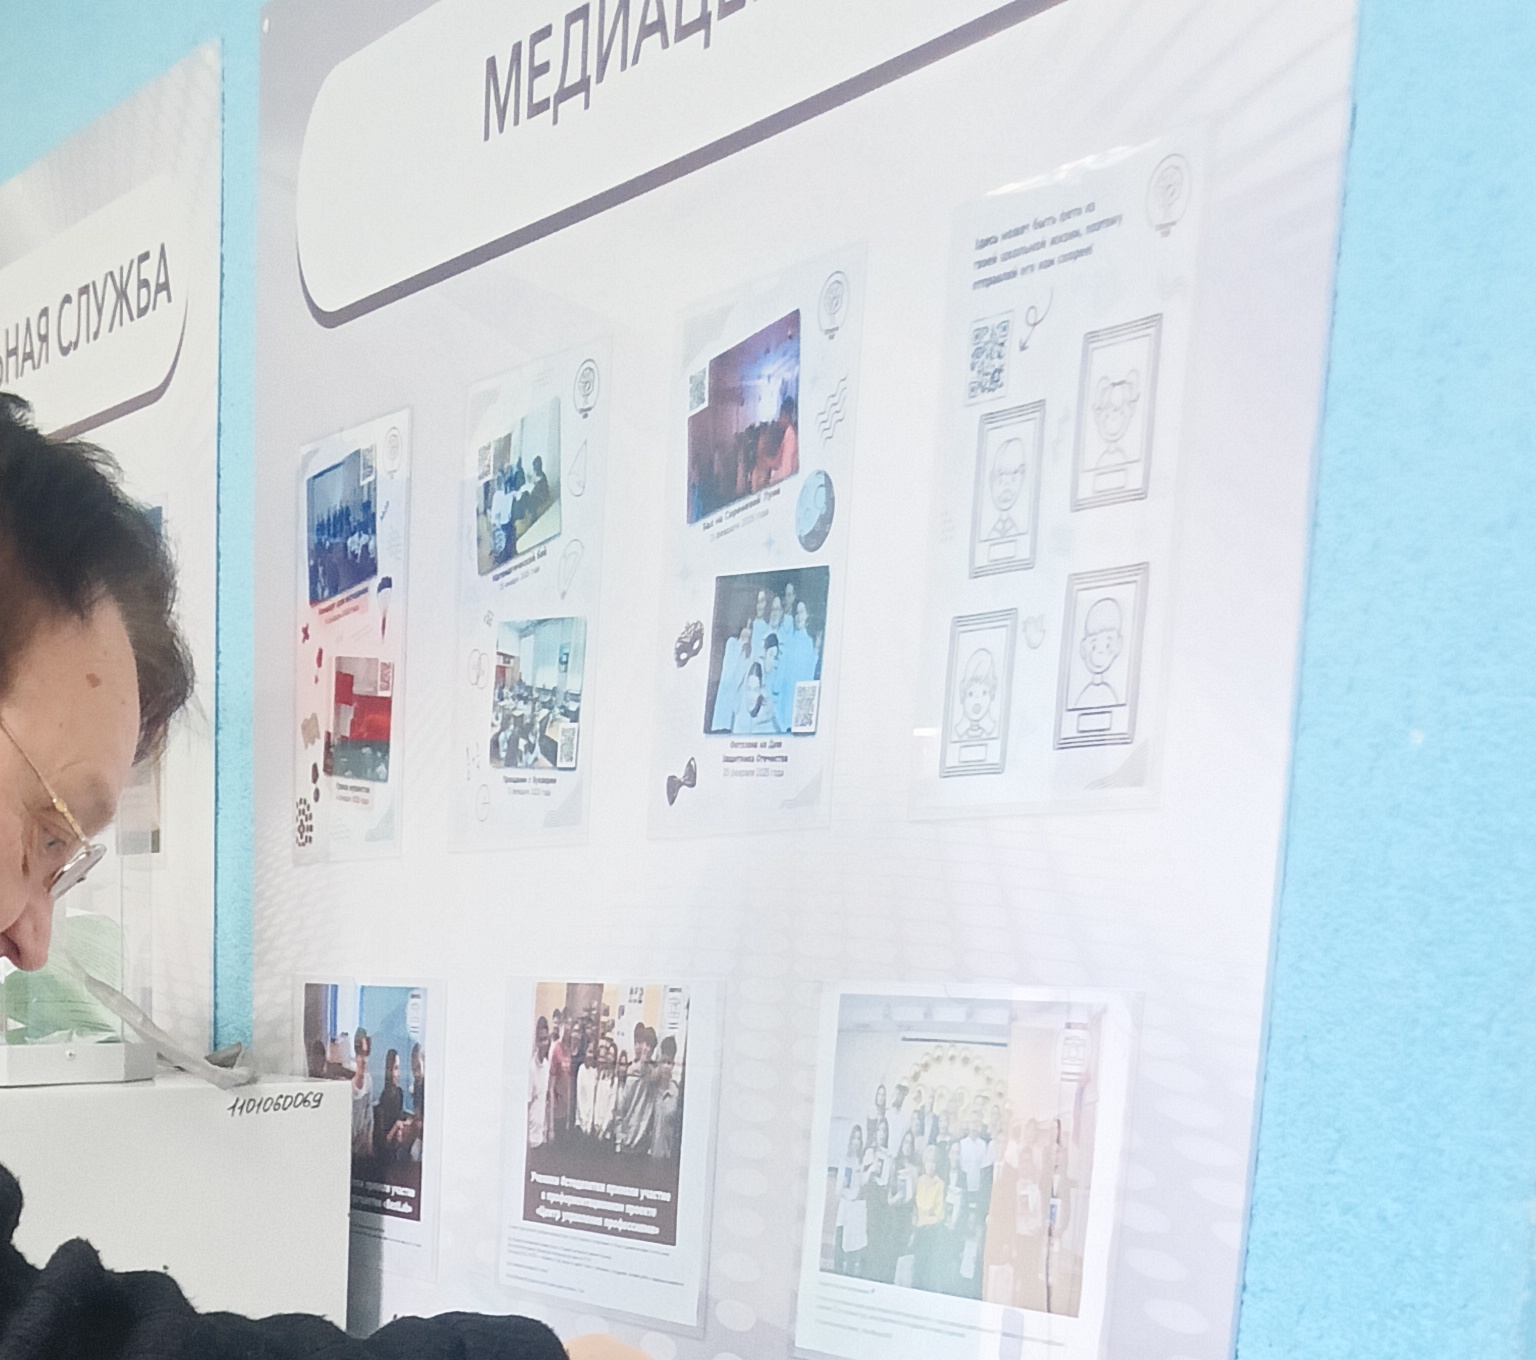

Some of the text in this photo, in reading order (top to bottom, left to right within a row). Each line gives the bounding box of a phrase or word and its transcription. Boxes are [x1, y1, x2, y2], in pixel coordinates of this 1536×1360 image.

[474, 0, 746, 142] МЕДИАЦ
[57, 242, 172, 357] СЛУЖБА
[227, 1091, 323, 1117] 1101060069
